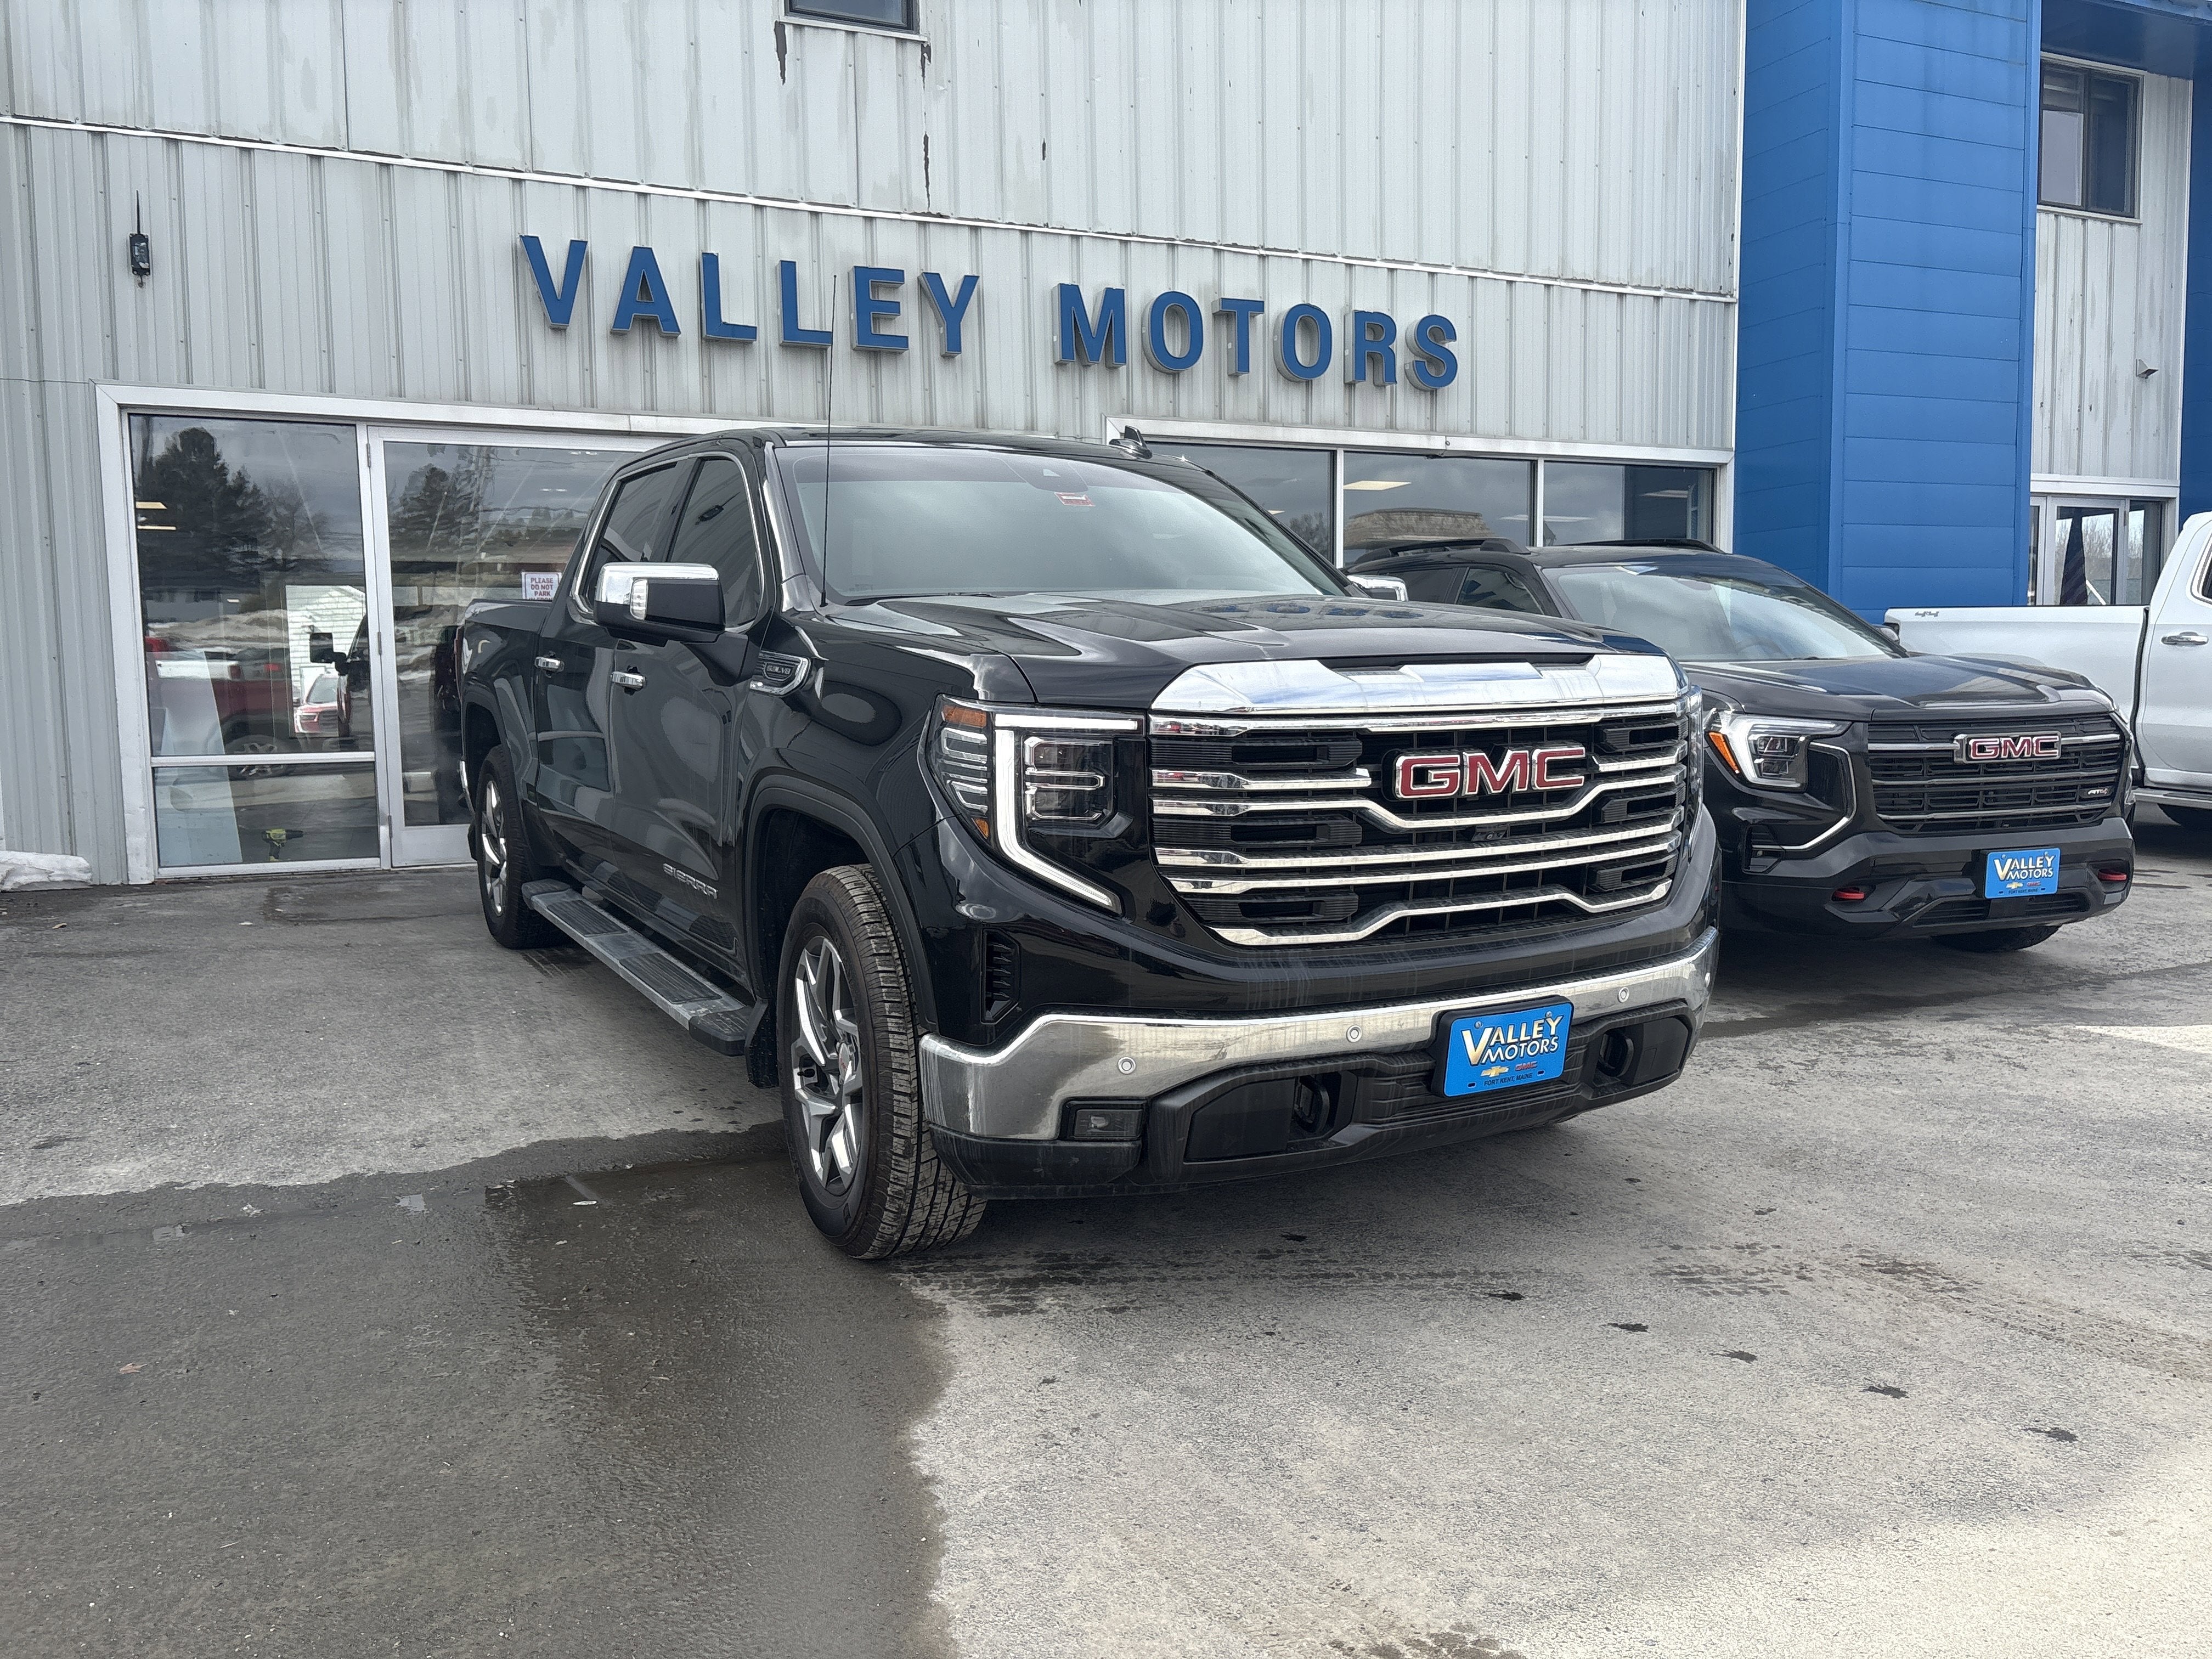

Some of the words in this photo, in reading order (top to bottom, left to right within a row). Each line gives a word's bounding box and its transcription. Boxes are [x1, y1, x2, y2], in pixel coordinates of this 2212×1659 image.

[519, 234, 980, 358] VALLEY
[1052, 283, 1458, 390] MOTORS
[1969, 735, 2059, 759] GMC
[1396, 747, 1585, 799] GMC
[663, 863, 718, 899] SIERRA
[1994, 855, 2056, 881] VALLEY
[2006, 867, 2054, 881] MOTORS
[1462, 1015, 1564, 1066] VALLEY
[1481, 1036, 1559, 1064] MOTORS
[1515, 1061, 1538, 1071] GMC
[1484, 1079, 1499, 1087] FORT
